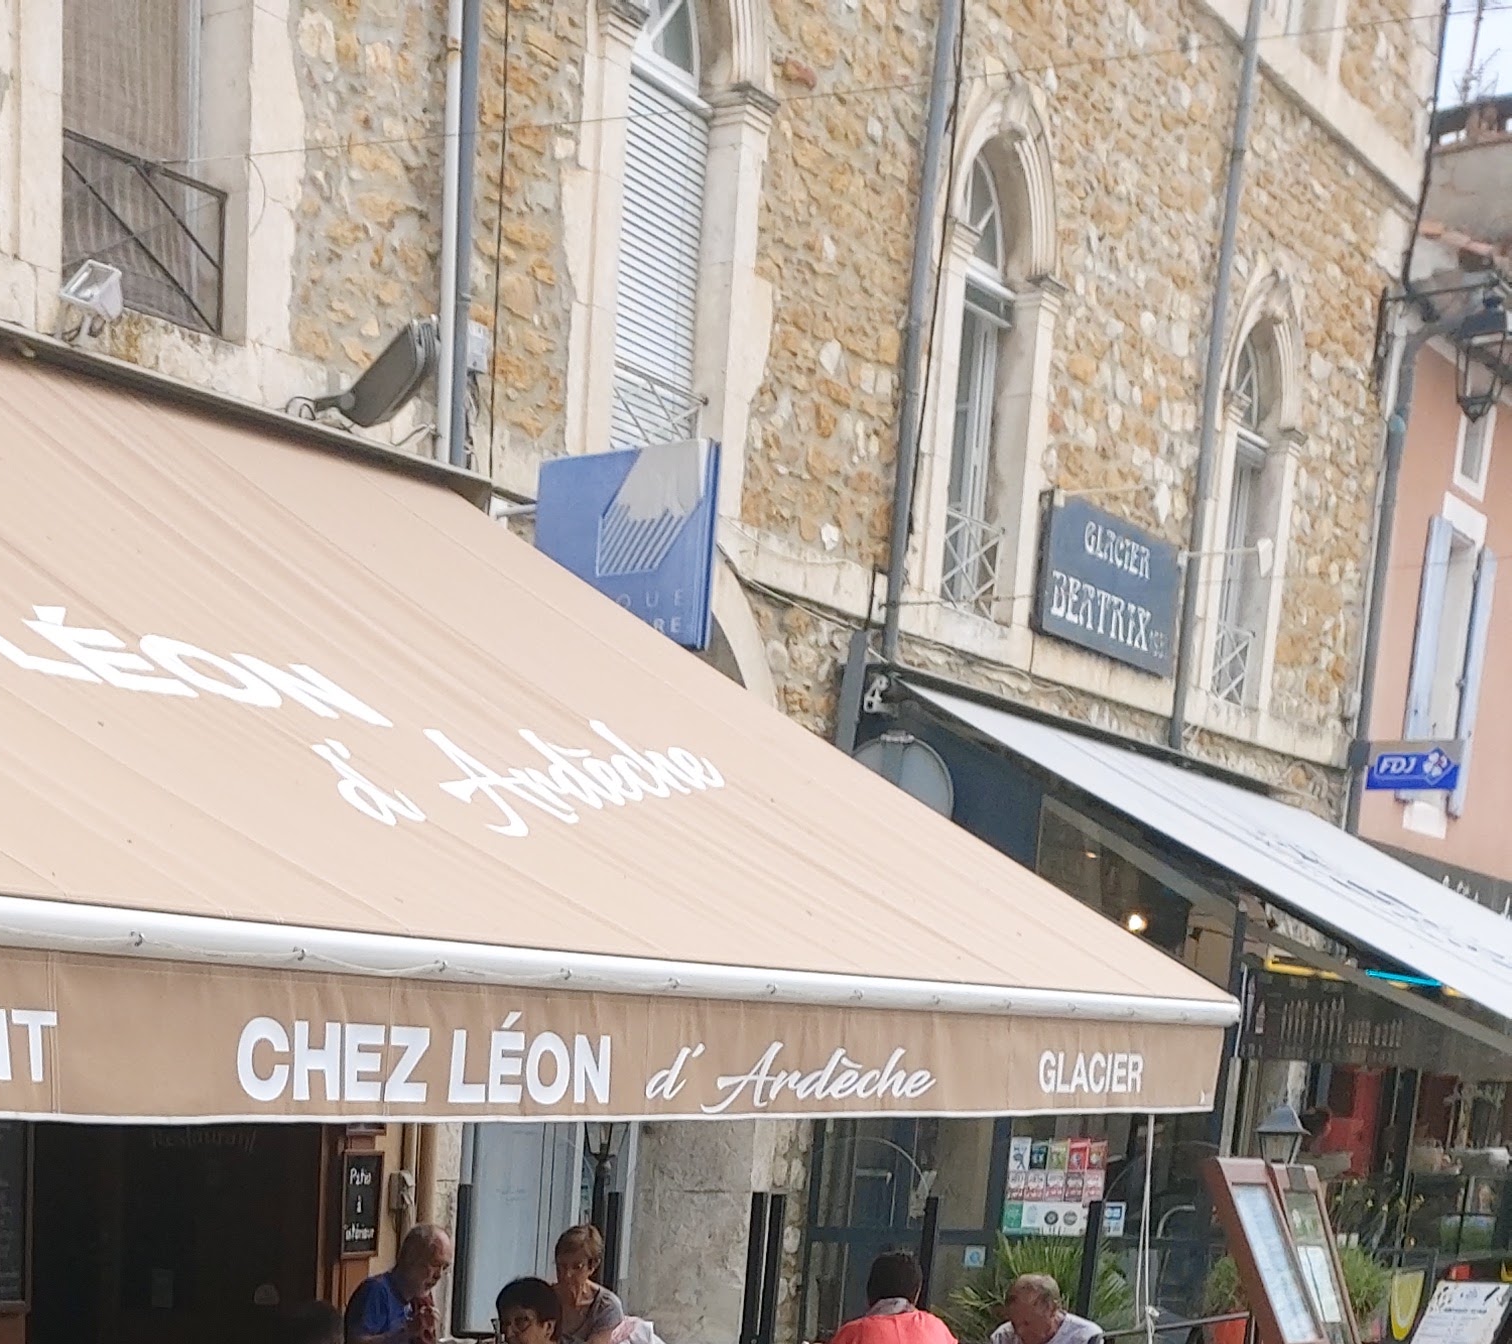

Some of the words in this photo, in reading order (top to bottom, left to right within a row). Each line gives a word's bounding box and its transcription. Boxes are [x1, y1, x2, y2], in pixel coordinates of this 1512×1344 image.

[1084, 521, 1151, 579] GLACIER
[1379, 756, 1418, 774] FDJ
[237, 1017, 431, 1103] CHEZ
[447, 1011, 612, 1105] LÉON
[701, 1041, 936, 1113] Ardèche
[1039, 1049, 1144, 1094] GLACIER
